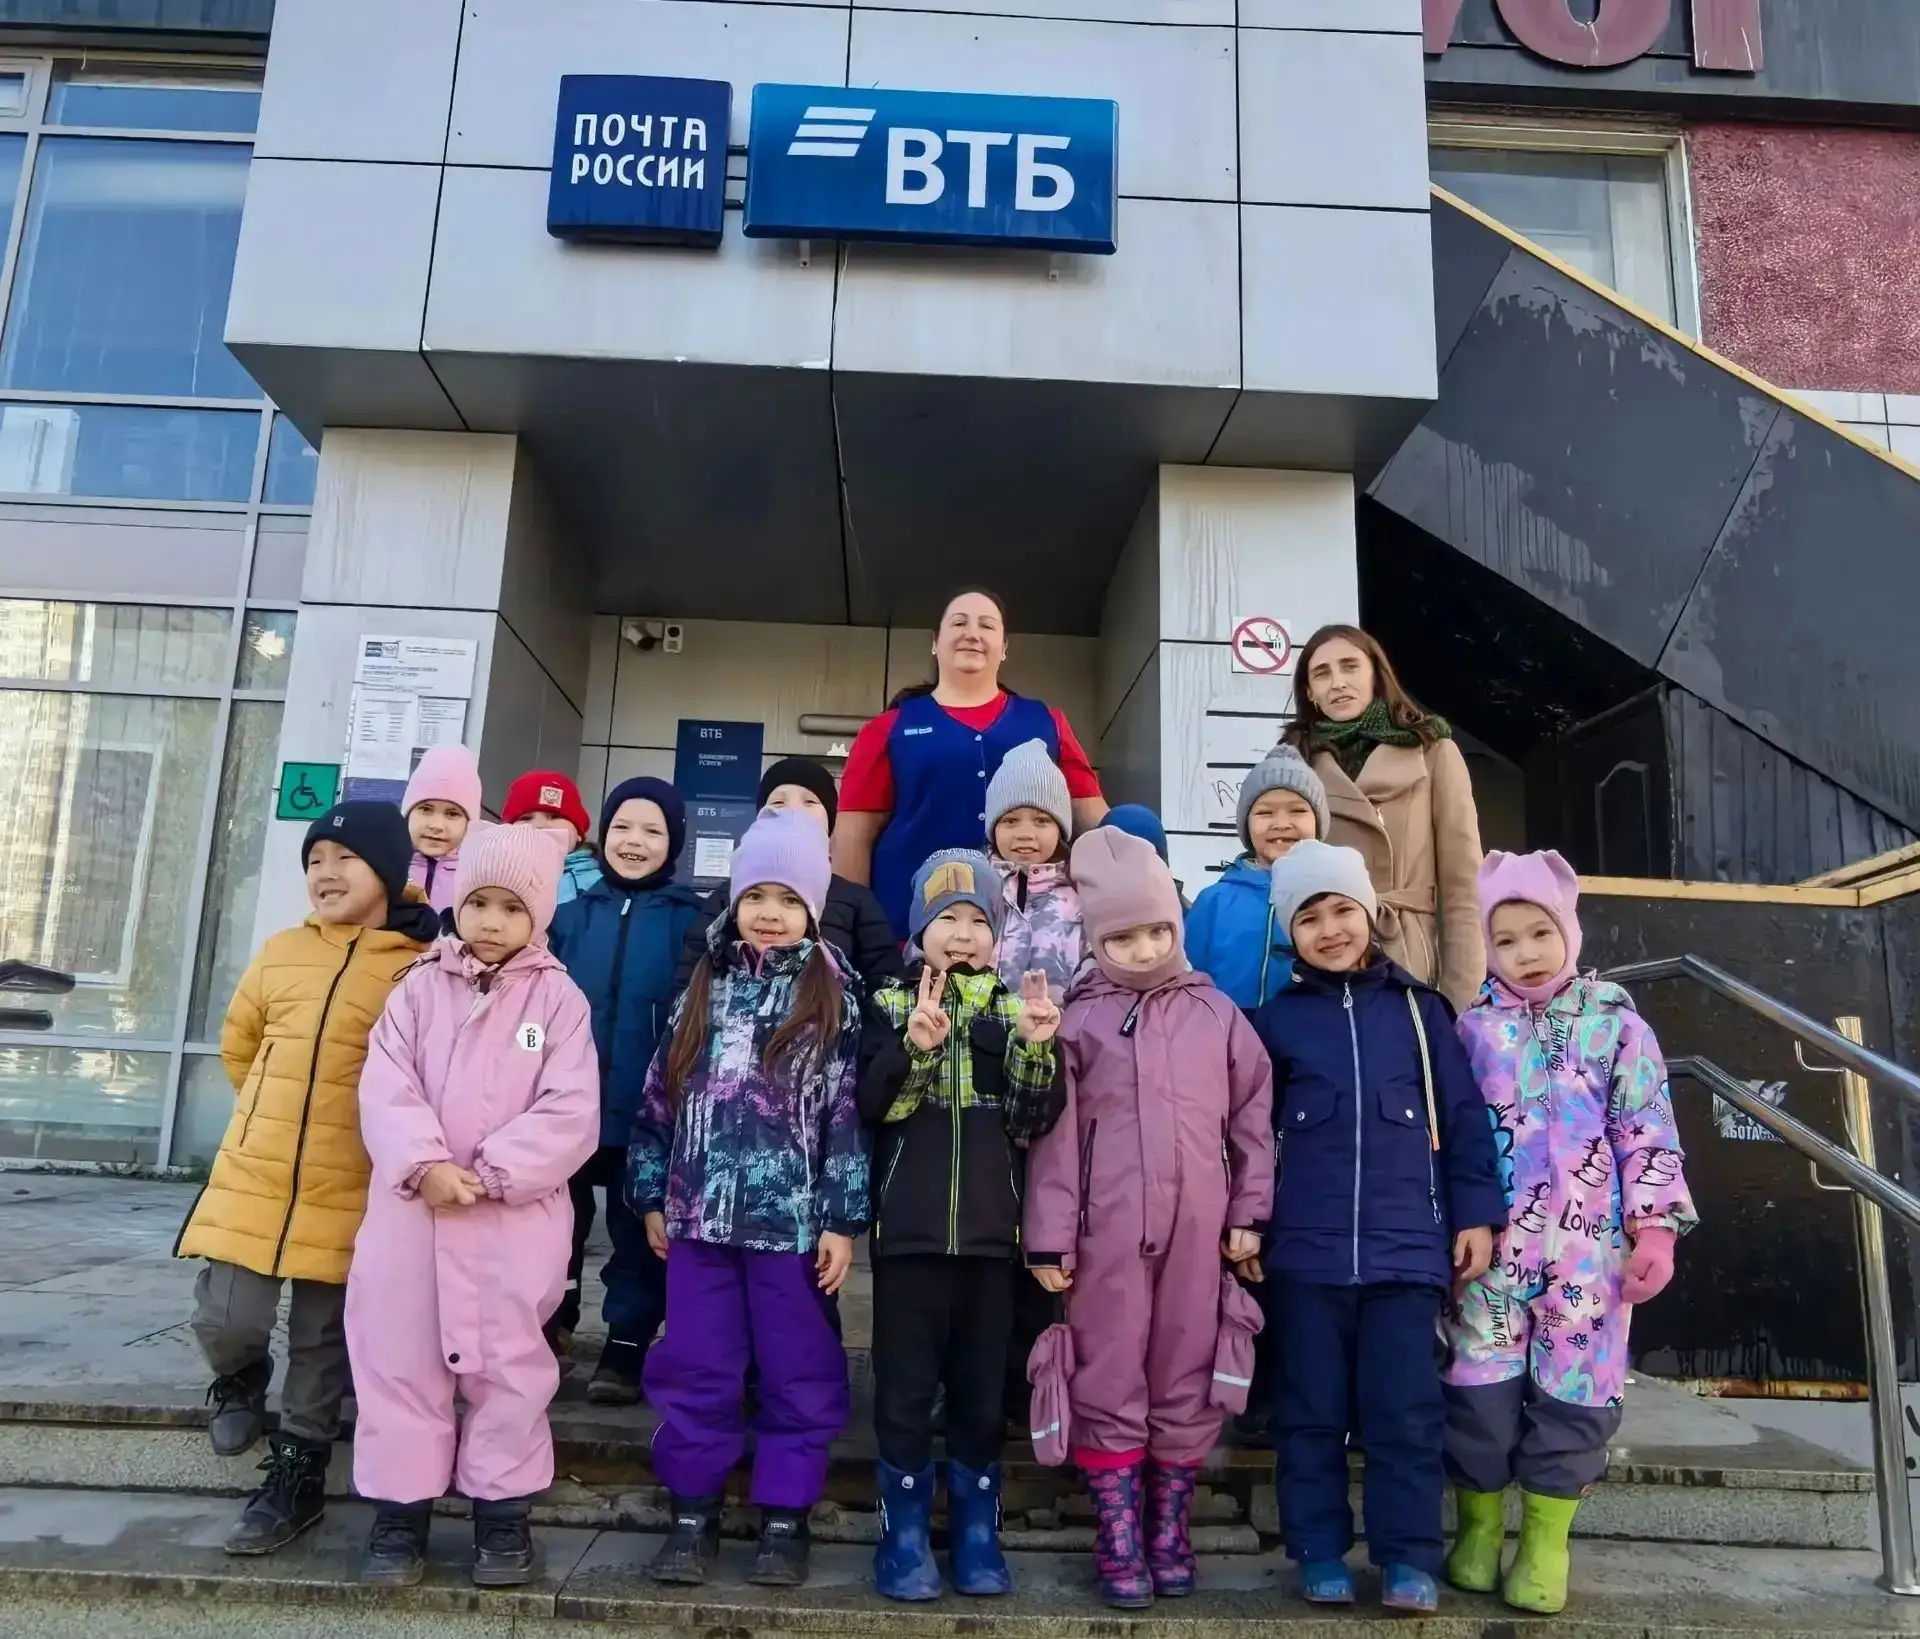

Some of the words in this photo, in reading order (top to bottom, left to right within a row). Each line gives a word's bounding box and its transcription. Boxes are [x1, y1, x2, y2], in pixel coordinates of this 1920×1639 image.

[574, 113, 707, 151] ПОЧТА
[571, 153, 704, 190] РОССИИ
[886, 127, 1075, 212] ВТБ
[700, 728, 722, 739] ВТБ
[697, 807, 717, 817] ВТБ
[1558, 1199, 1601, 1241] Love
